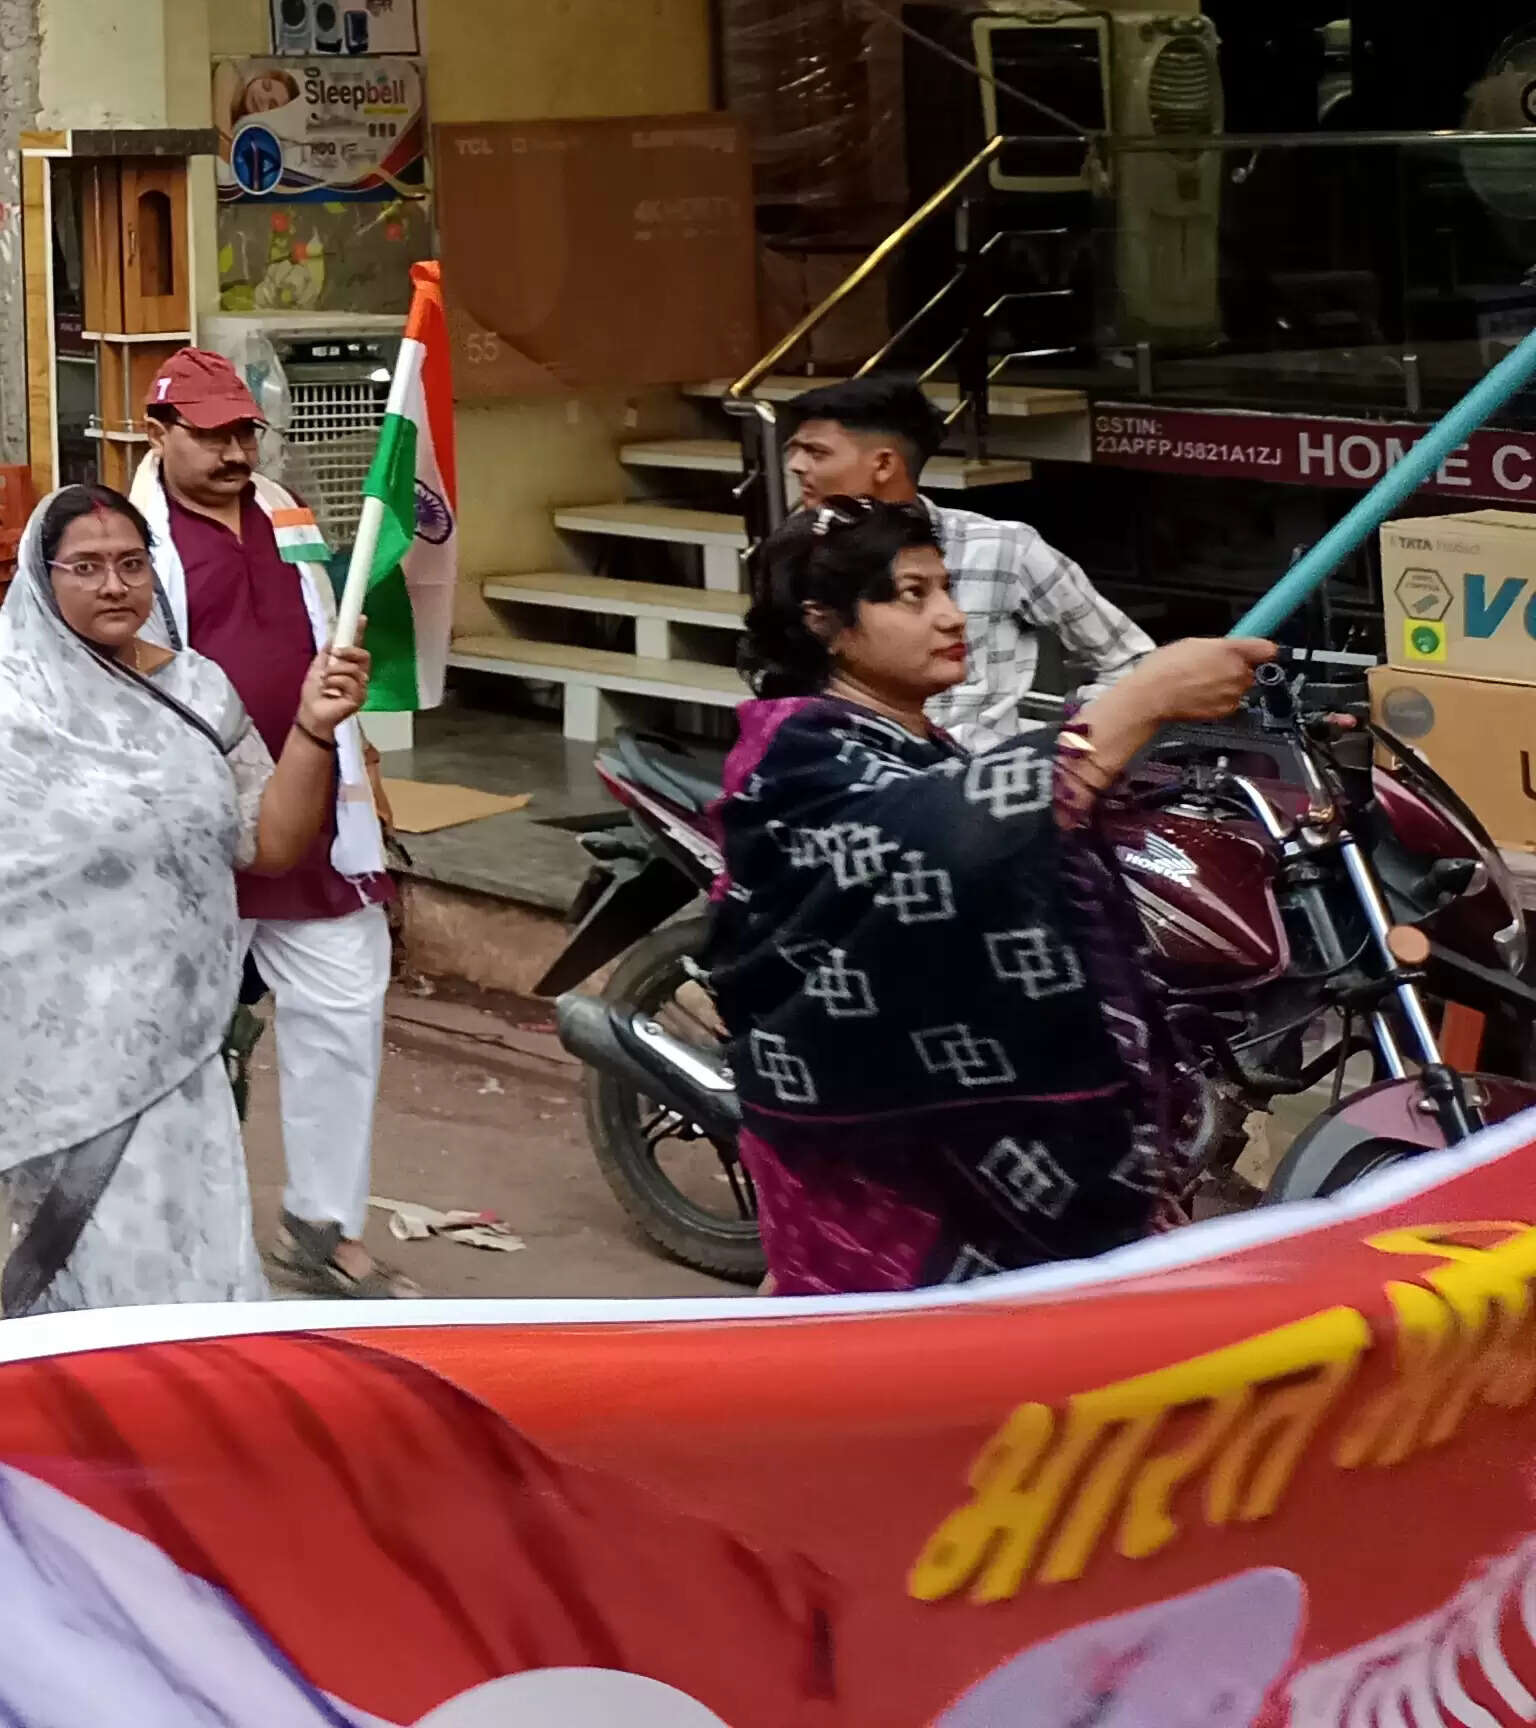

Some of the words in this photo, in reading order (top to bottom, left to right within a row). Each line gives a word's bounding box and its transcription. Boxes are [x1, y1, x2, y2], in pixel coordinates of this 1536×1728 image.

[304, 78, 406, 112] Sleepbell
[454, 138, 495, 155] TCL
[466, 331, 498, 364] 55
[1095, 415, 1163, 437] GSTIN:
[1398, 535, 1433, 552] TATA
[1463, 572, 1536, 640] V
[908, 1306, 1372, 1604] भारत
